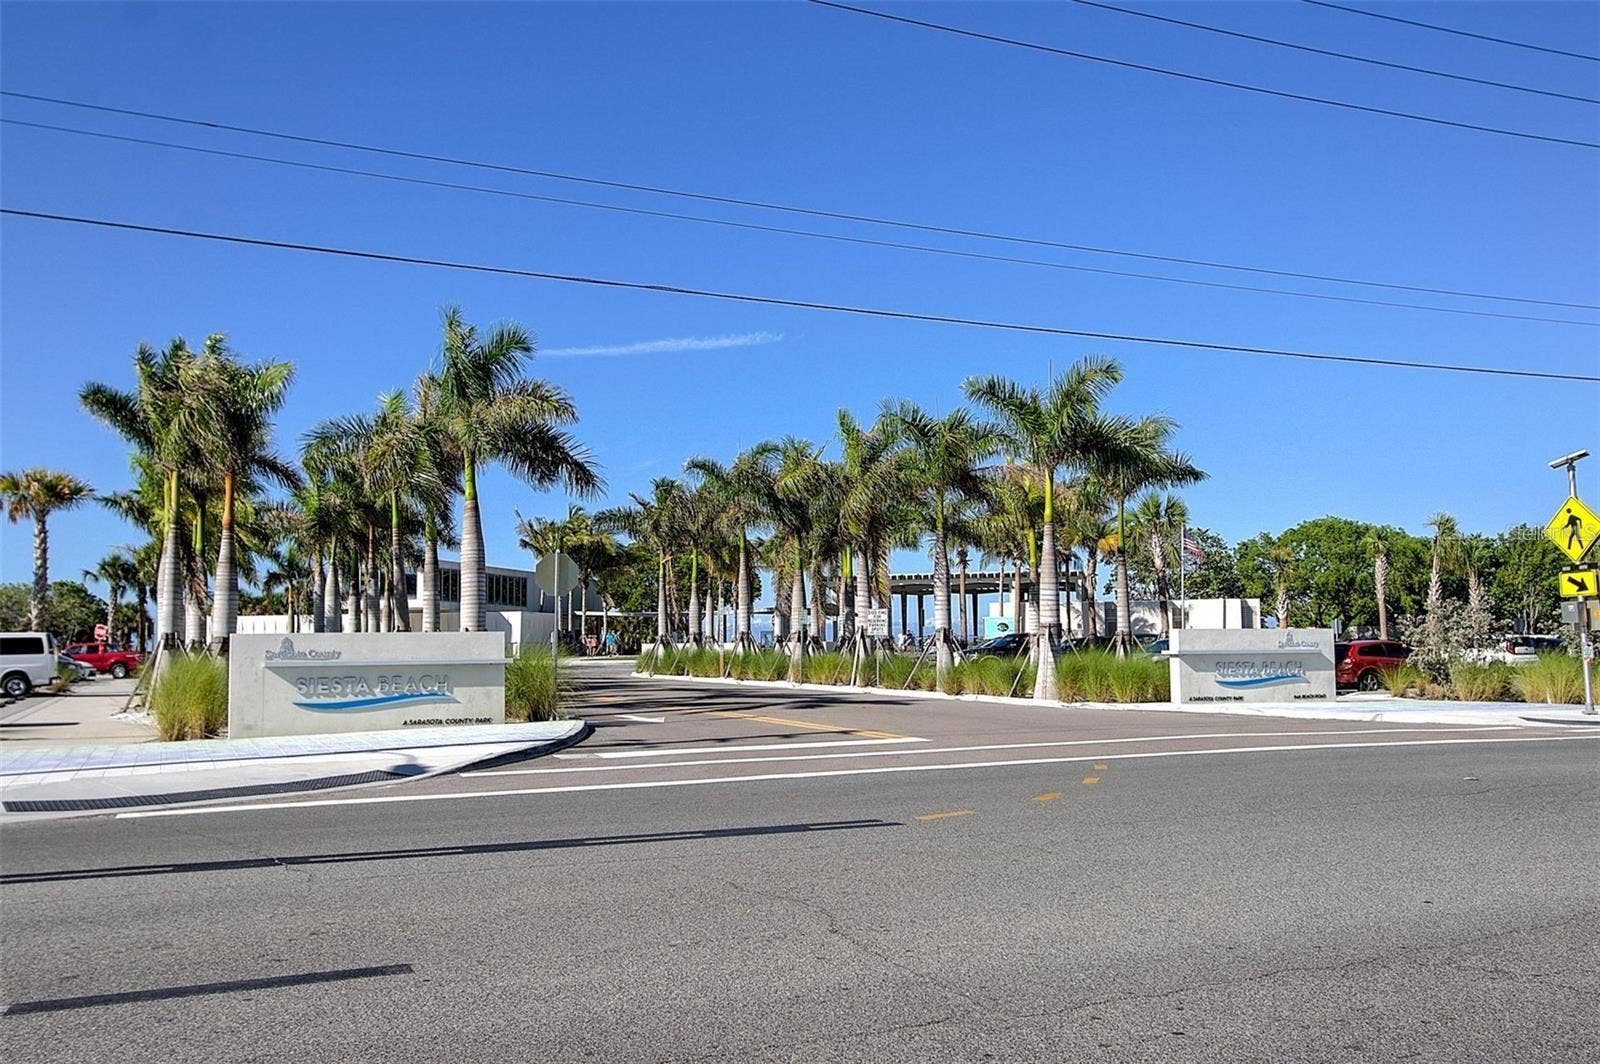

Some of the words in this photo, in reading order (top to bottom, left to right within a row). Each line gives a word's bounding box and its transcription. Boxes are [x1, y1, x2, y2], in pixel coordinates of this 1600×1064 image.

[1215, 661, 1258, 675] SIESTA
[1262, 660, 1303, 675] BEACH
[295, 675, 370, 694] SIESTA
[377, 674, 449, 692] BEACH
[409, 718, 443, 726] SARASOTA
[444, 717, 474, 725] COUNTY
[475, 716, 493, 724] PARK
